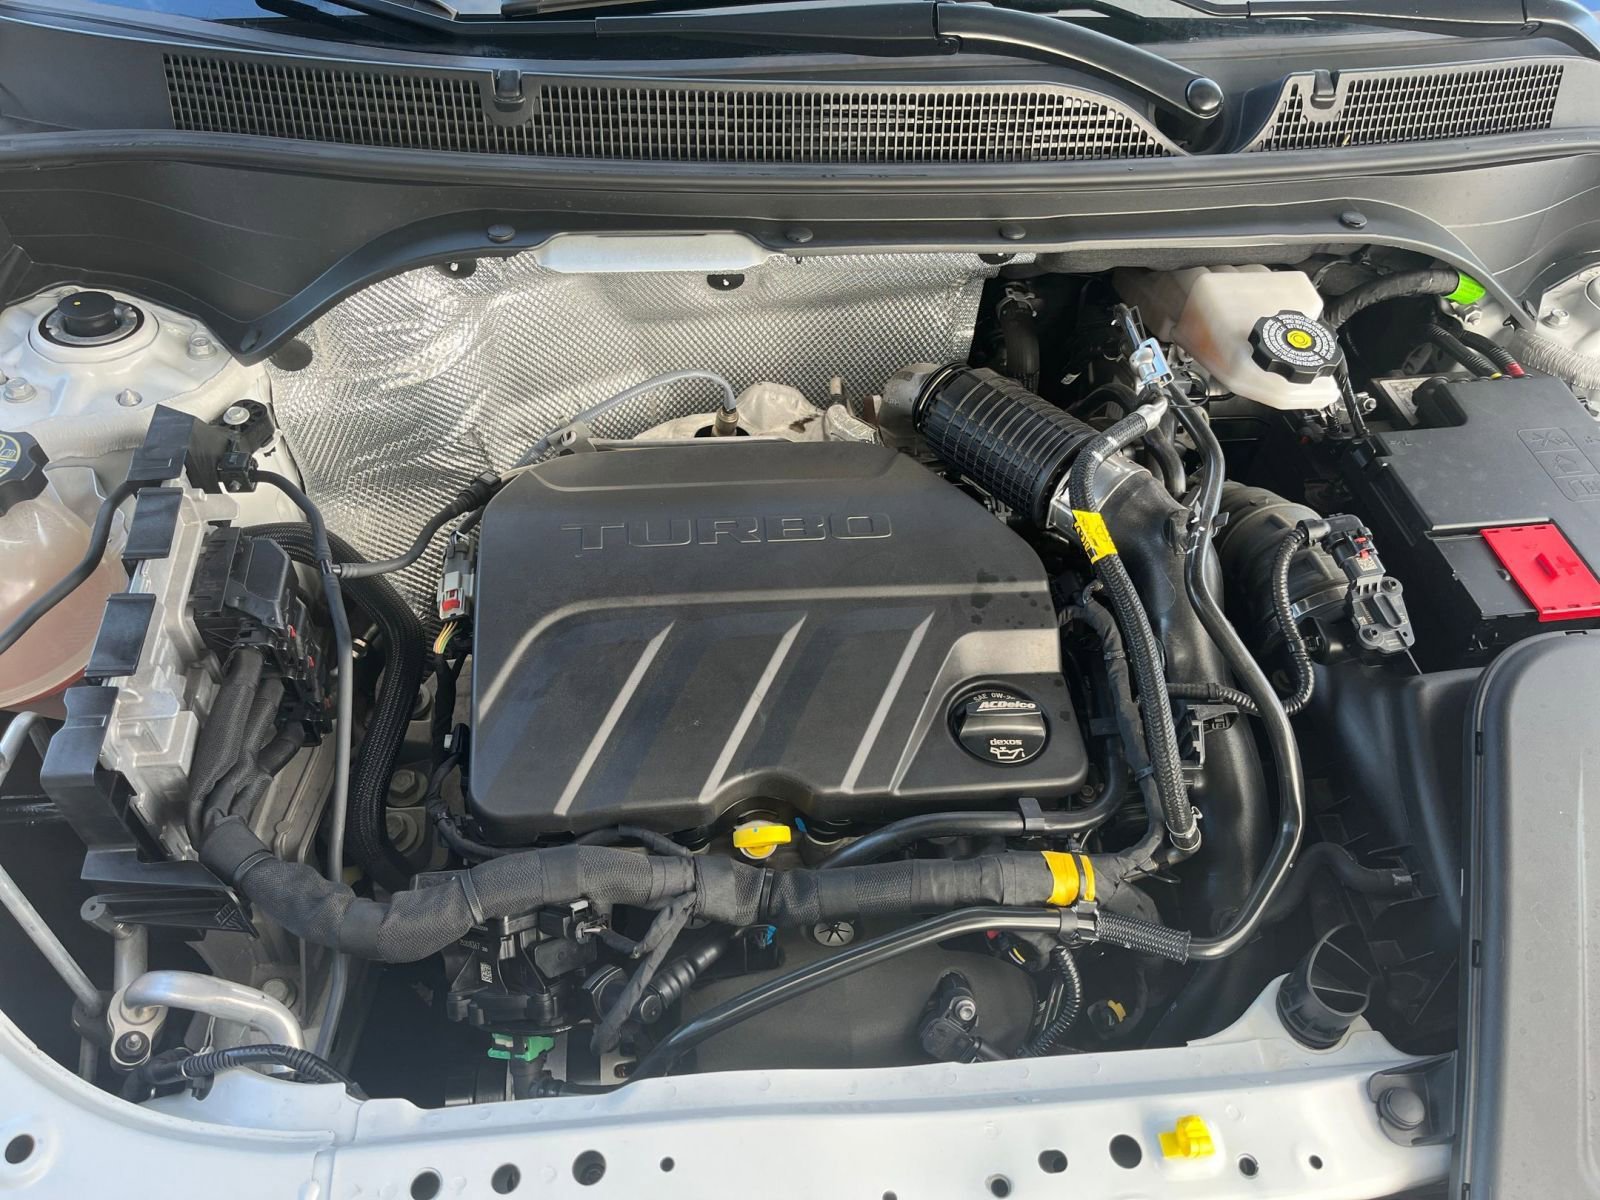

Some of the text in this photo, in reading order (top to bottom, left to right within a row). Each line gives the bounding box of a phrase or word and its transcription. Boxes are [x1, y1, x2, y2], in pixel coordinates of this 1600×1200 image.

[560, 512, 893, 551] TURBO
[973, 693, 989, 702] SAE
[979, 701, 1036, 709] ACDelco
[989, 738, 1023, 746] dexos
